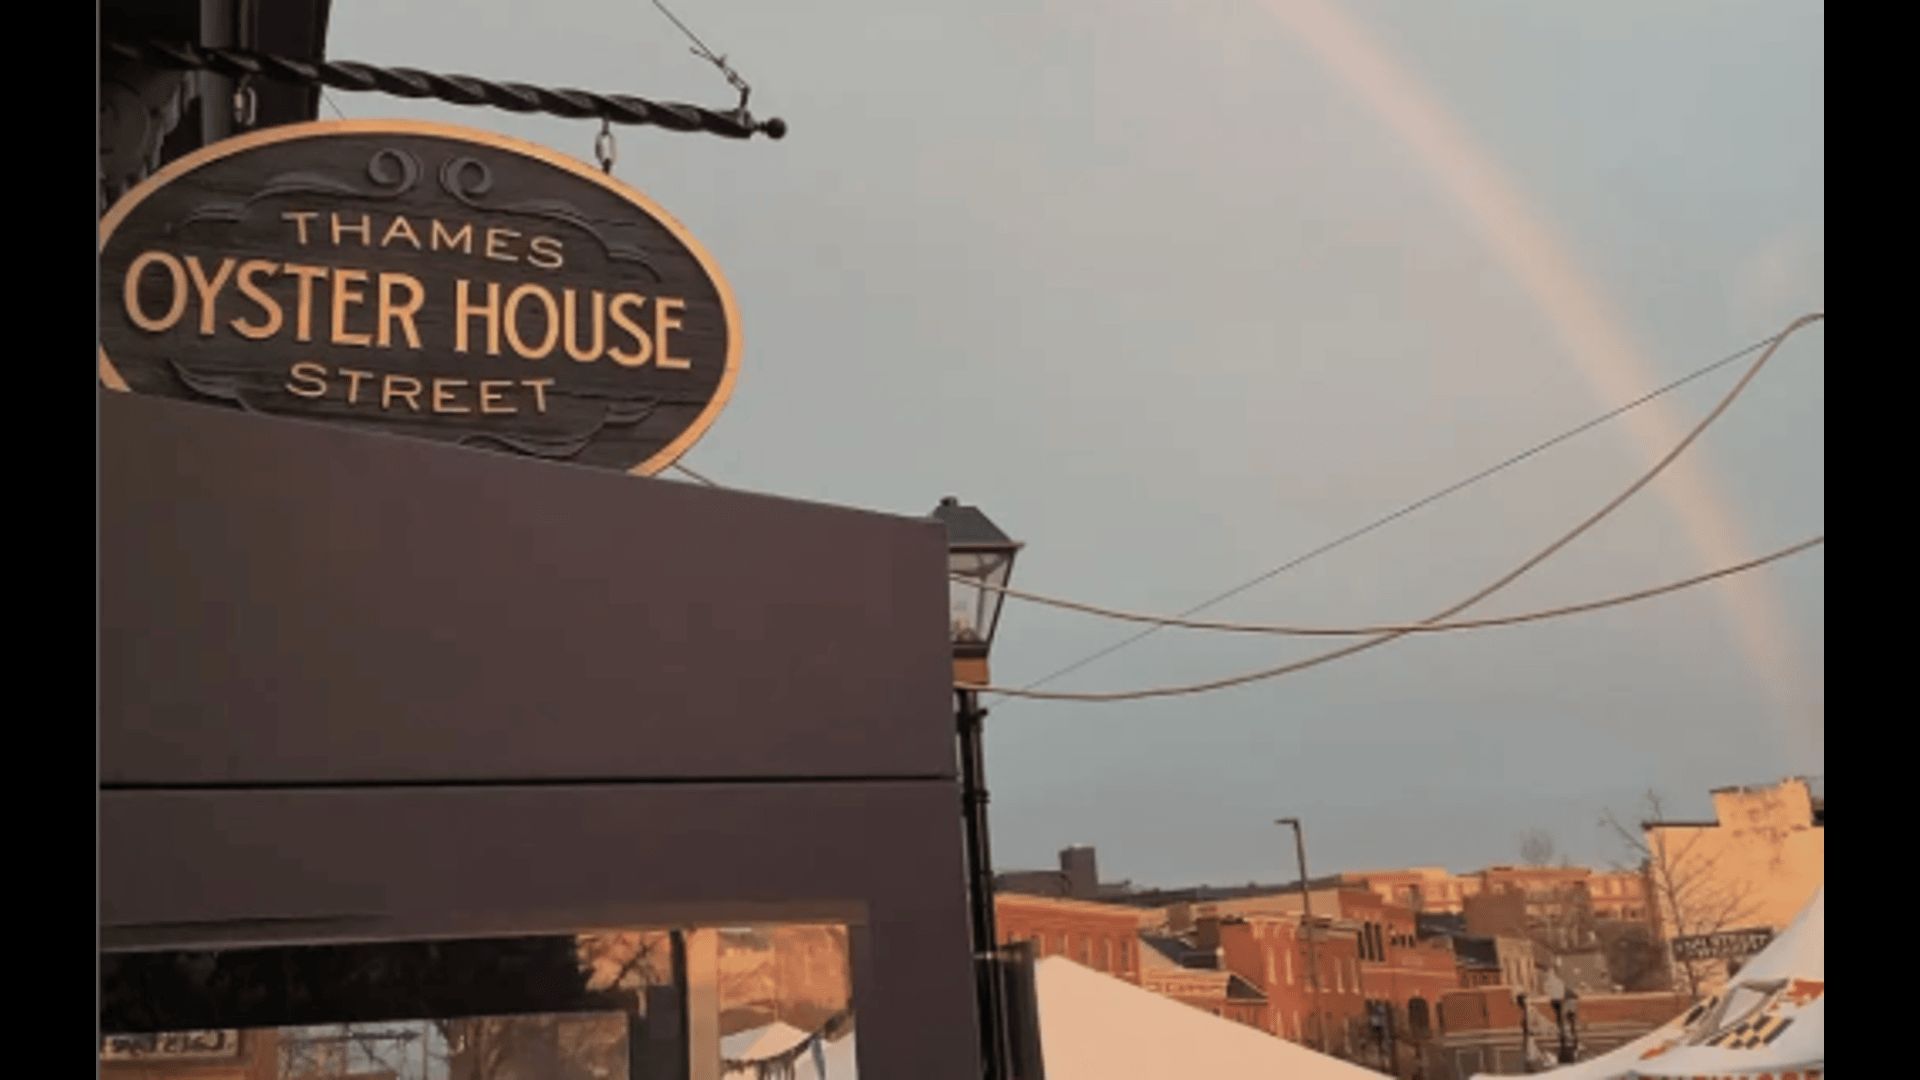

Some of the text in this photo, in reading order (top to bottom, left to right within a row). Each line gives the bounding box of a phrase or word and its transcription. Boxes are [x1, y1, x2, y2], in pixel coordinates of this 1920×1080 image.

[281, 211, 564, 268] THAMES
[124, 251, 691, 369] OYSTER HOUSE
[286, 362, 556, 413] STREET
